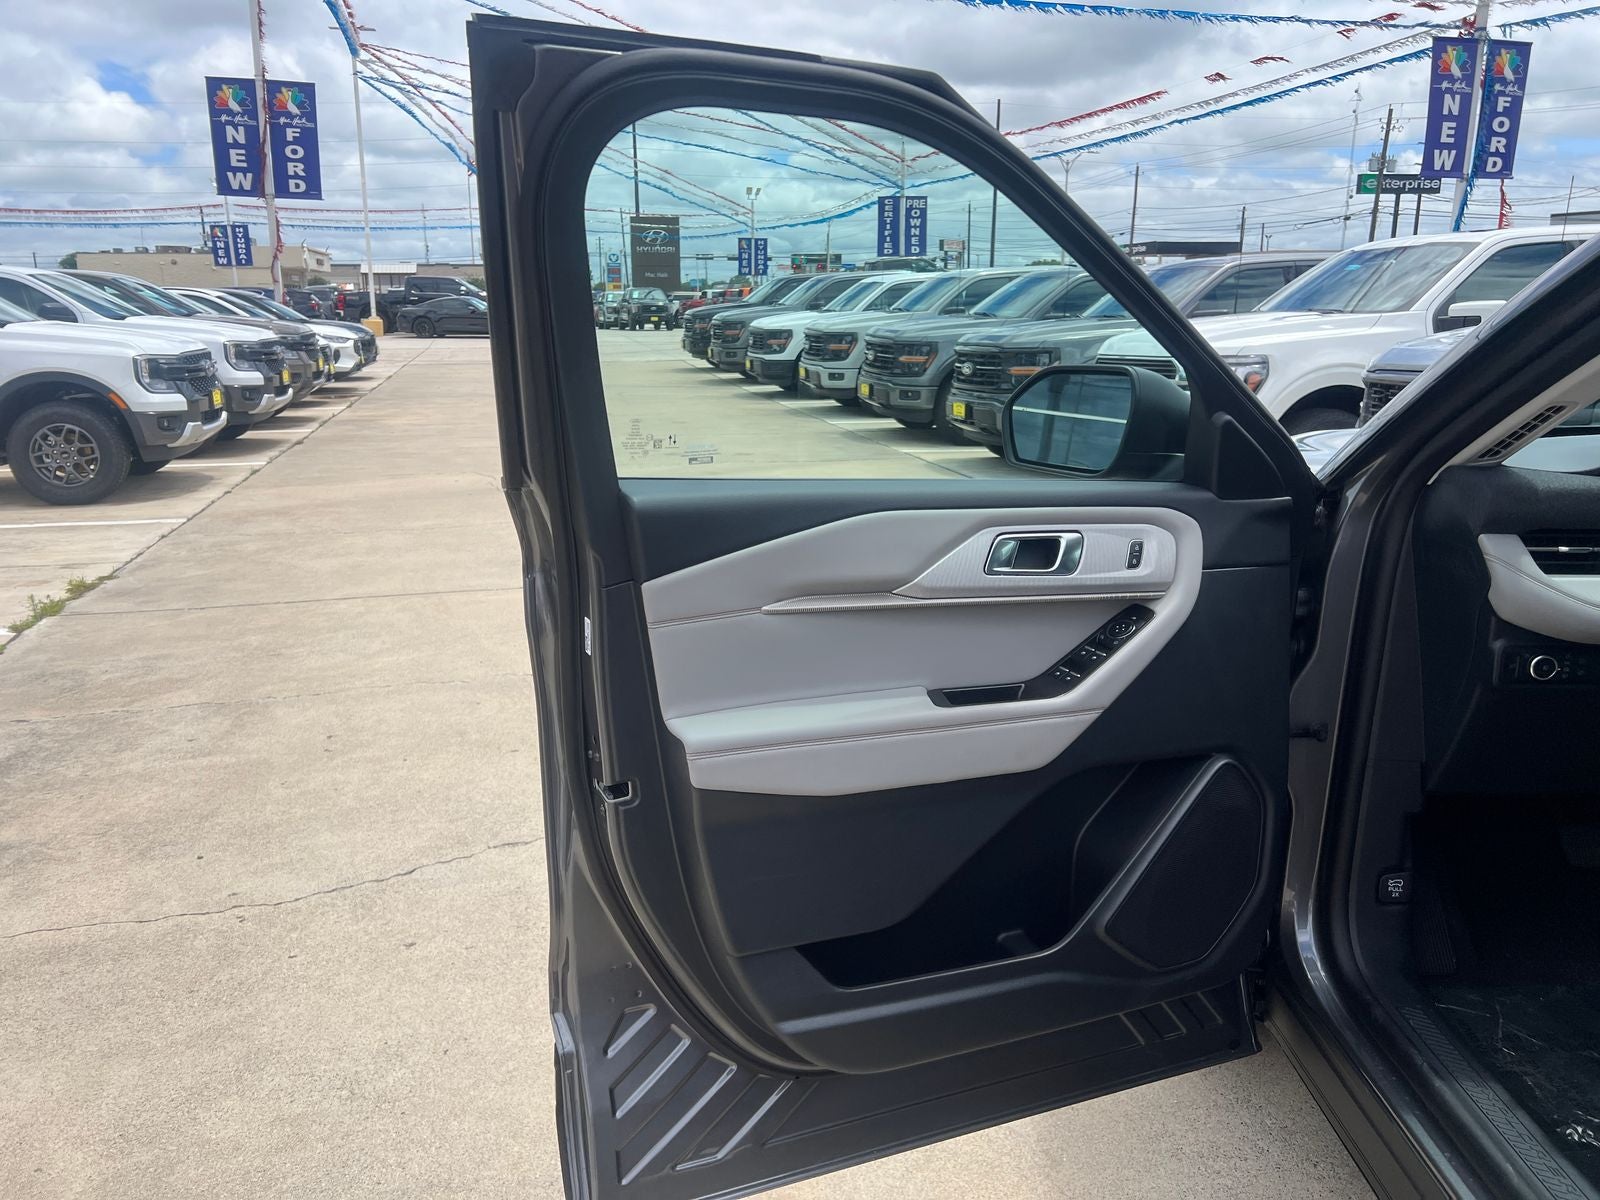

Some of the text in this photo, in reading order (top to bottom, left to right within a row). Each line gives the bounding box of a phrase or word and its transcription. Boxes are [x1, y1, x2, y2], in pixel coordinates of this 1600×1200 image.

[1433, 93, 1460, 171] NEW
[1485, 96, 1511, 173] FORD
[225, 125, 253, 191] NEW
[284, 127, 307, 193] FORD
[906, 199, 926, 208] PRE
[235, 227, 247, 265] HYUNDAI
[883, 198, 894, 255] CERTIFIED
[910, 209, 921, 254] OWNED
[216, 240, 228, 265] NEW
[741, 252, 750, 274] NEW
[757, 240, 765, 274] HYUNDAI
